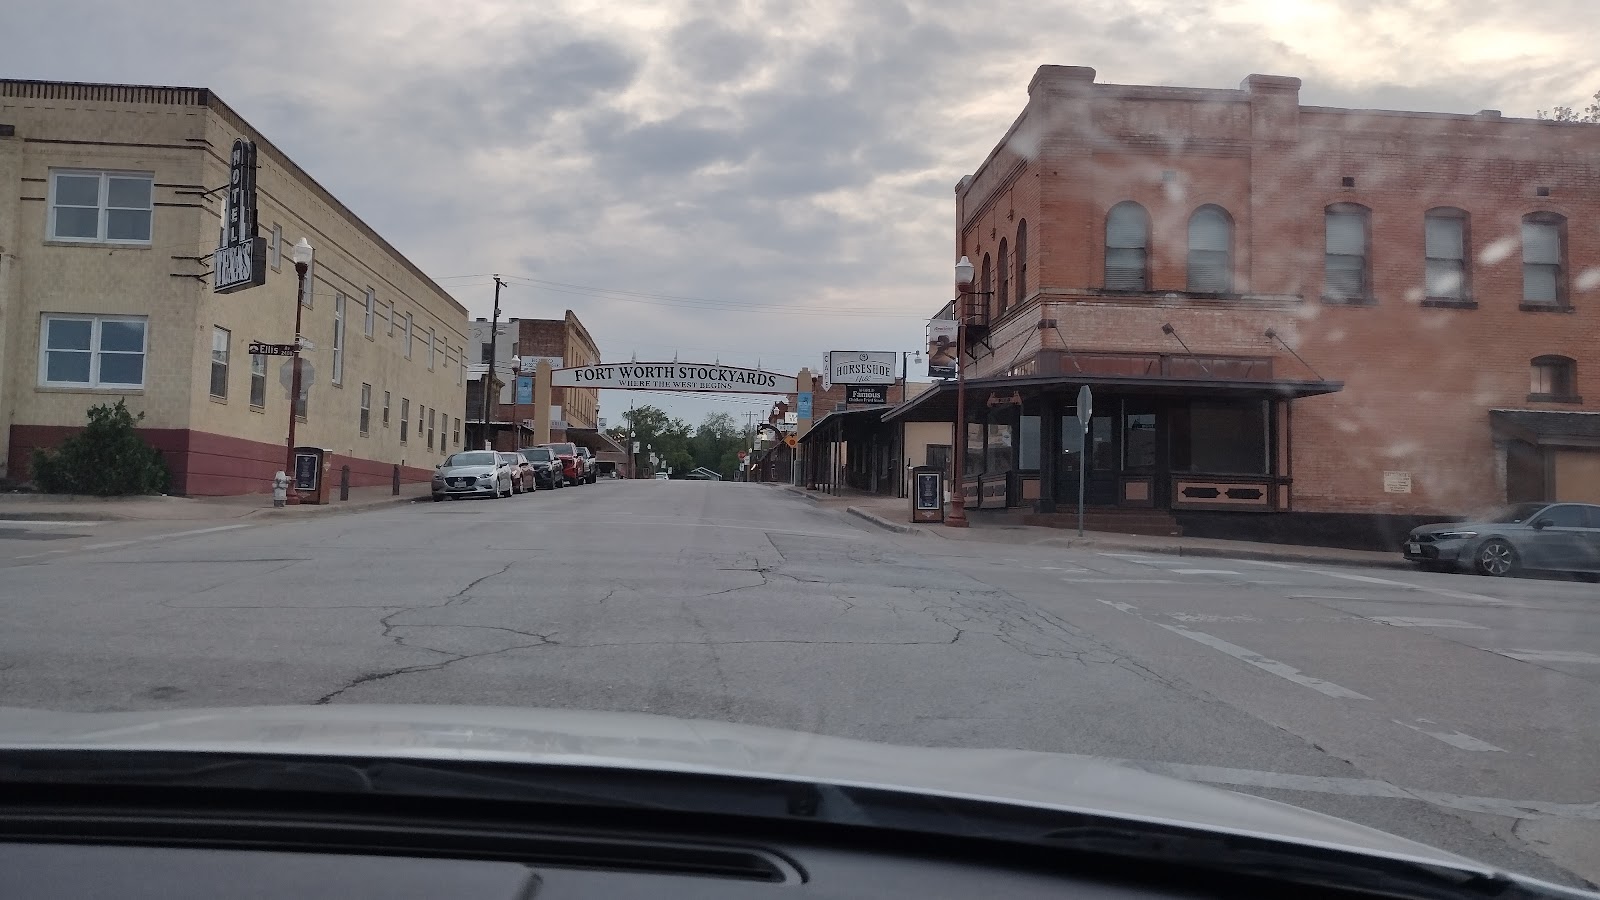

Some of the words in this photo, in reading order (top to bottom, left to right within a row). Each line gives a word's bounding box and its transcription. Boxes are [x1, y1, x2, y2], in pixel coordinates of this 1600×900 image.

[230, 149, 241, 242] HOTEL
[214, 242, 252, 288] TEXAS
[259, 345, 279, 355] Ellis
[574, 367, 615, 382] FORT
[619, 366, 675, 379] WORTH
[678, 367, 776, 387] STOCKYARDS
[836, 363, 891, 377] HORSESHOE
[619, 379, 651, 387] WHERE
[653, 380, 671, 388] THE
[699, 382, 733, 390] BEGINS
[852, 390, 881, 398] Famous
